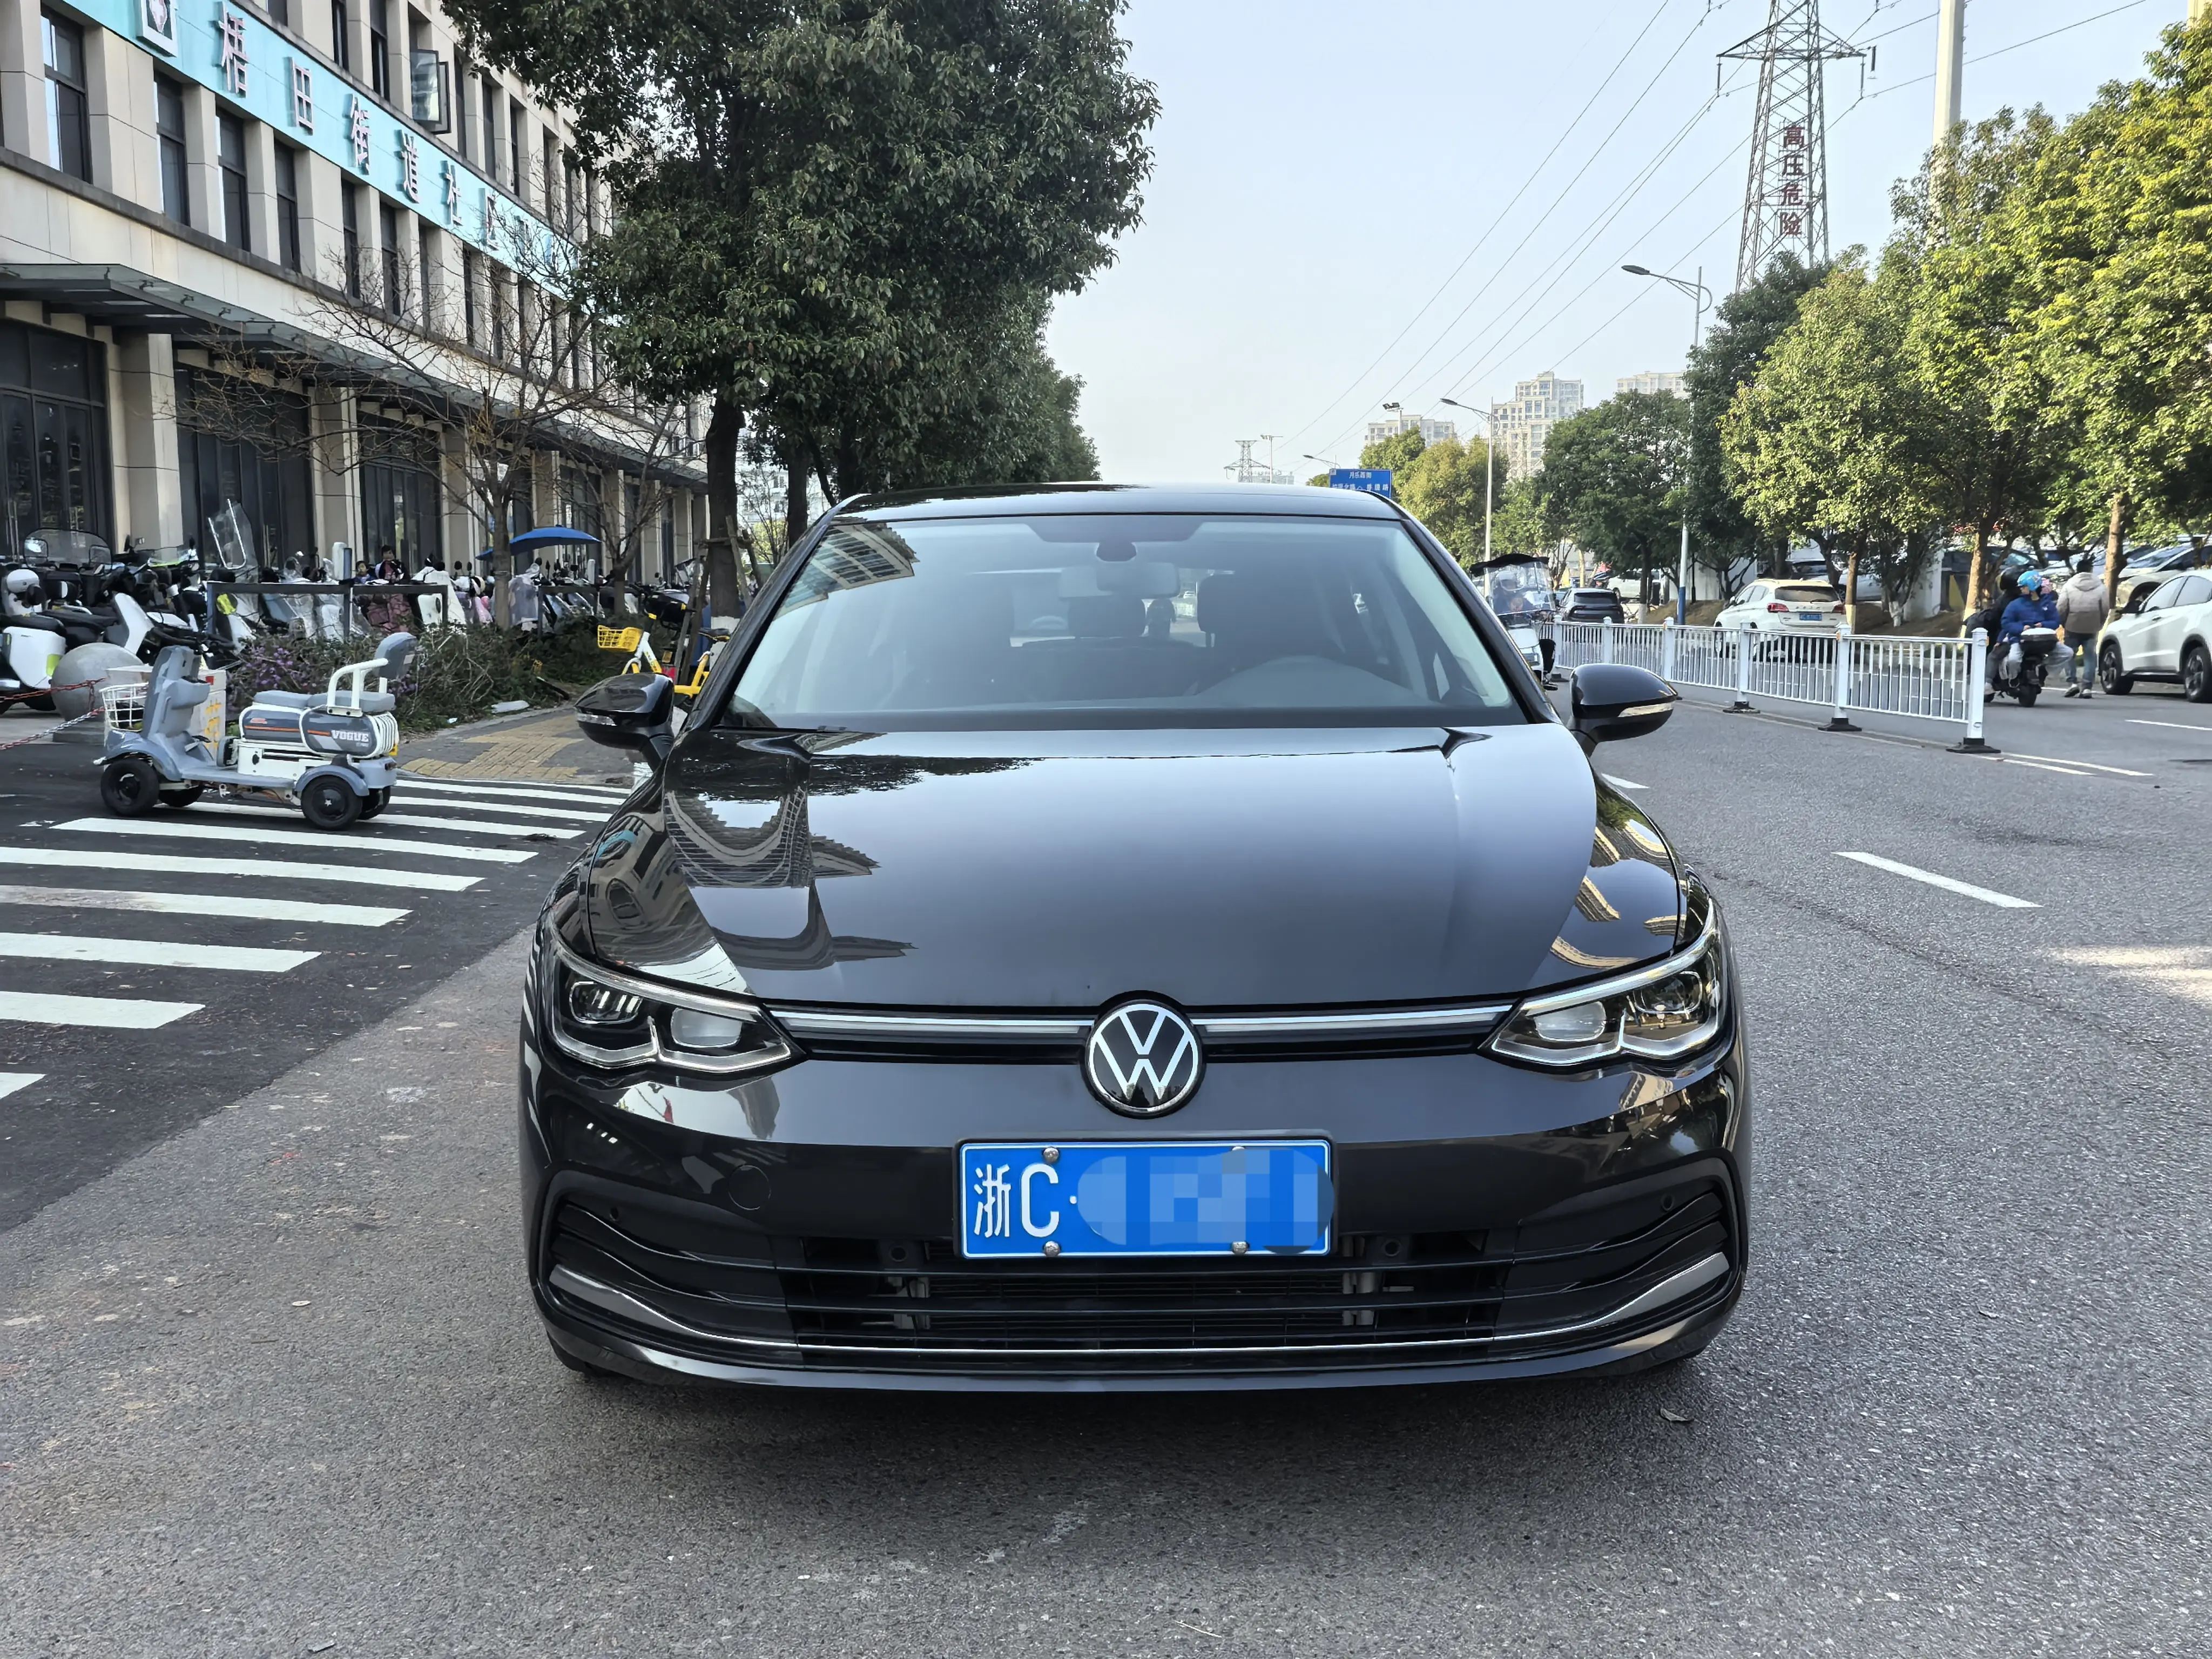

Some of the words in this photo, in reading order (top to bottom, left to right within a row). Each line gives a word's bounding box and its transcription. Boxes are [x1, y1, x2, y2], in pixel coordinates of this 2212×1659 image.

[1780, 125, 1804, 235] 高压危险
[331, 730, 369, 742] VOGUE
